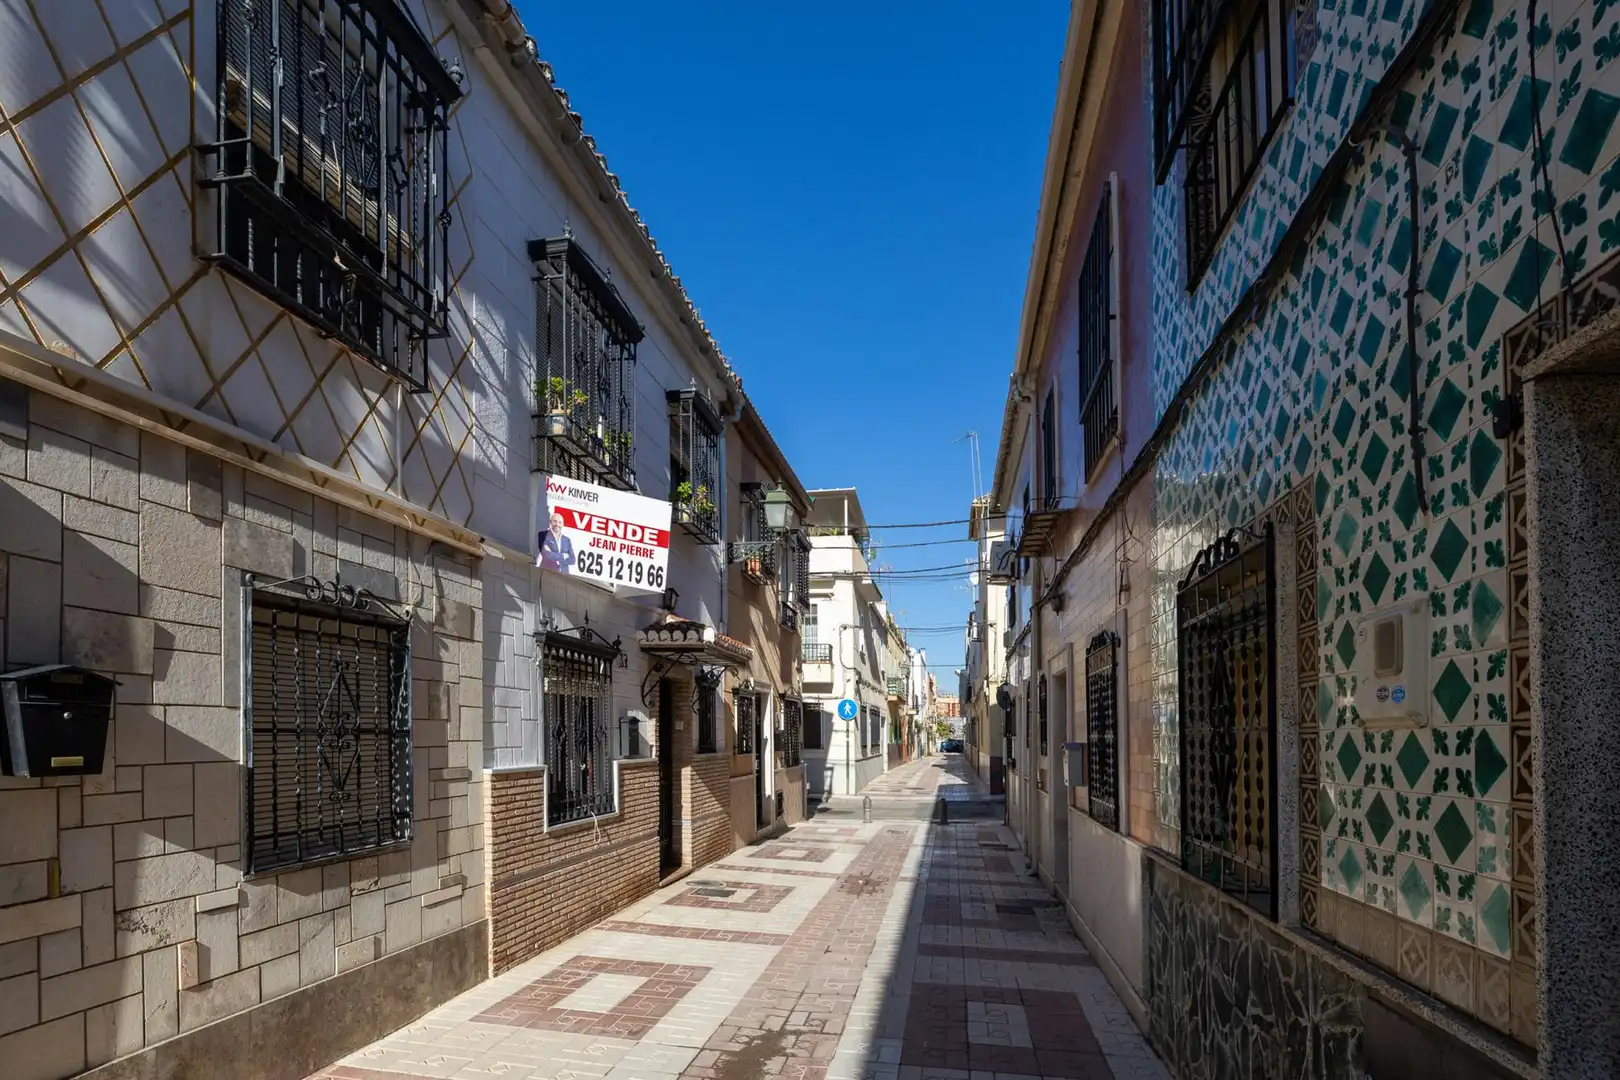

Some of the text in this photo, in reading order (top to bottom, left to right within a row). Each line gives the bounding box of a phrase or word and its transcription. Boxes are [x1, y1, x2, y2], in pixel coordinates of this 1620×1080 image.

[546, 475, 567, 495] kw
[568, 486, 599, 503] KINVER
[572, 511, 659, 545] VENDE
[589, 537, 655, 559] JEAN PIERRE
[577, 550, 664, 588] 625 12 19 66
